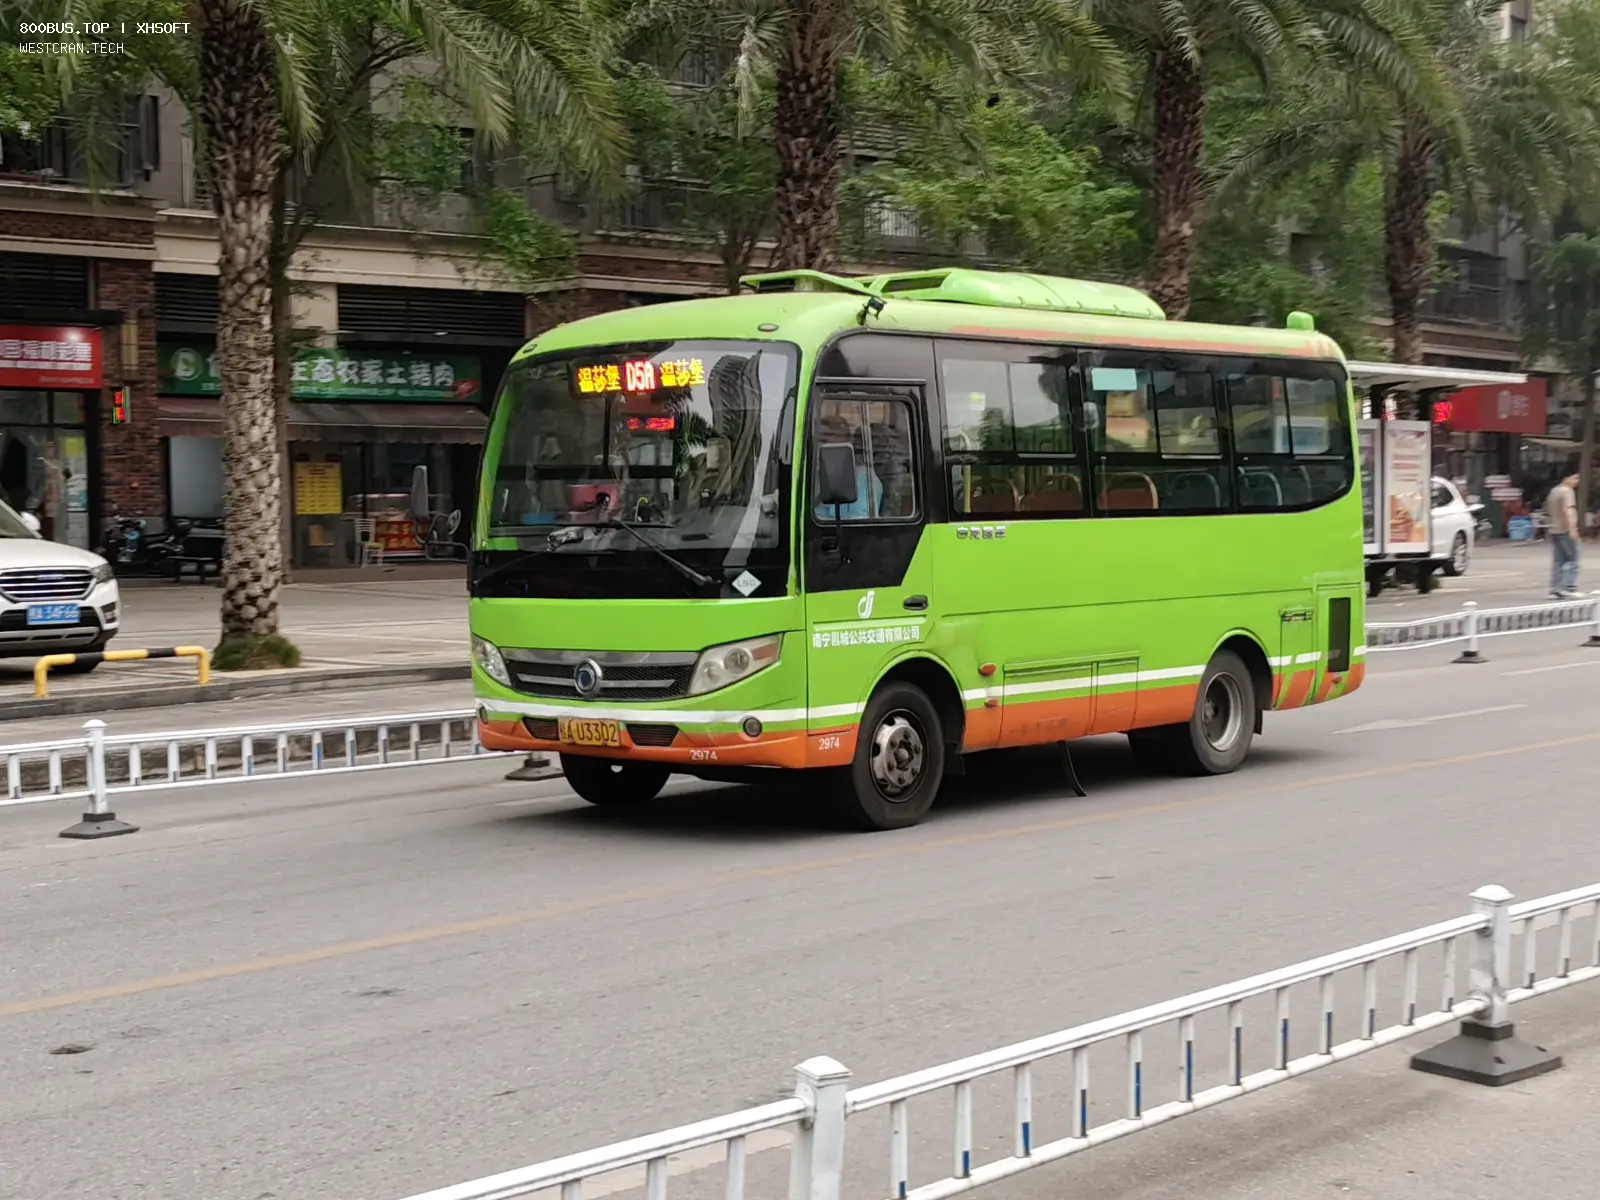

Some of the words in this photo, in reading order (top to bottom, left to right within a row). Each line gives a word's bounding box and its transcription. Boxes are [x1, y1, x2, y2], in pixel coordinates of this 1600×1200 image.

[578, 364, 622, 392] 温莎堡
[625, 360, 656, 391] D5A
[660, 358, 705, 387] 温莎堡
[737, 579, 757, 587] LNG
[818, 736, 841, 751] 2974
[689, 749, 718, 761] 2974
